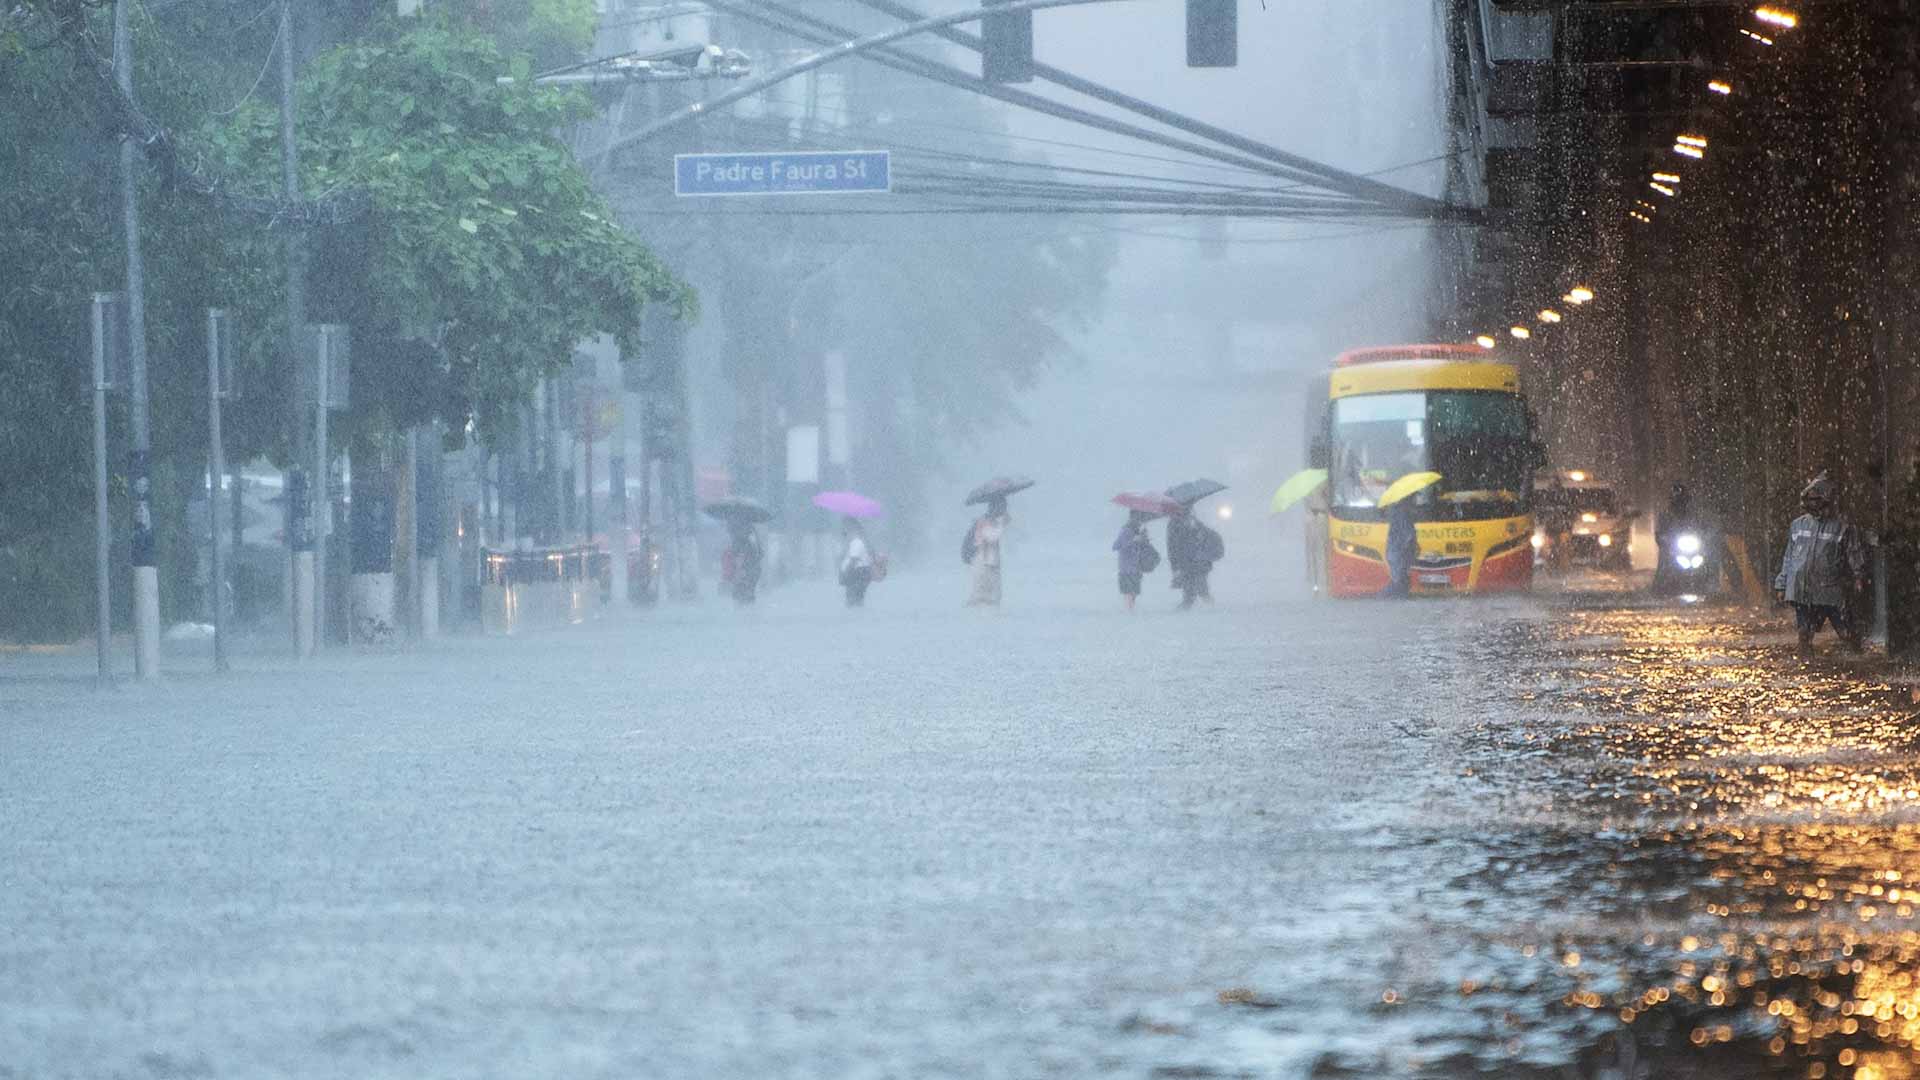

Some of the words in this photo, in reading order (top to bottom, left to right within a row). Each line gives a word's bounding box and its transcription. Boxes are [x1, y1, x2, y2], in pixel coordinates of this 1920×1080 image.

[697, 161, 764, 182] Padre
[771, 160, 837, 180] Faura
[844, 158, 867, 178] St
[1418, 527, 1476, 539] MUTERS
